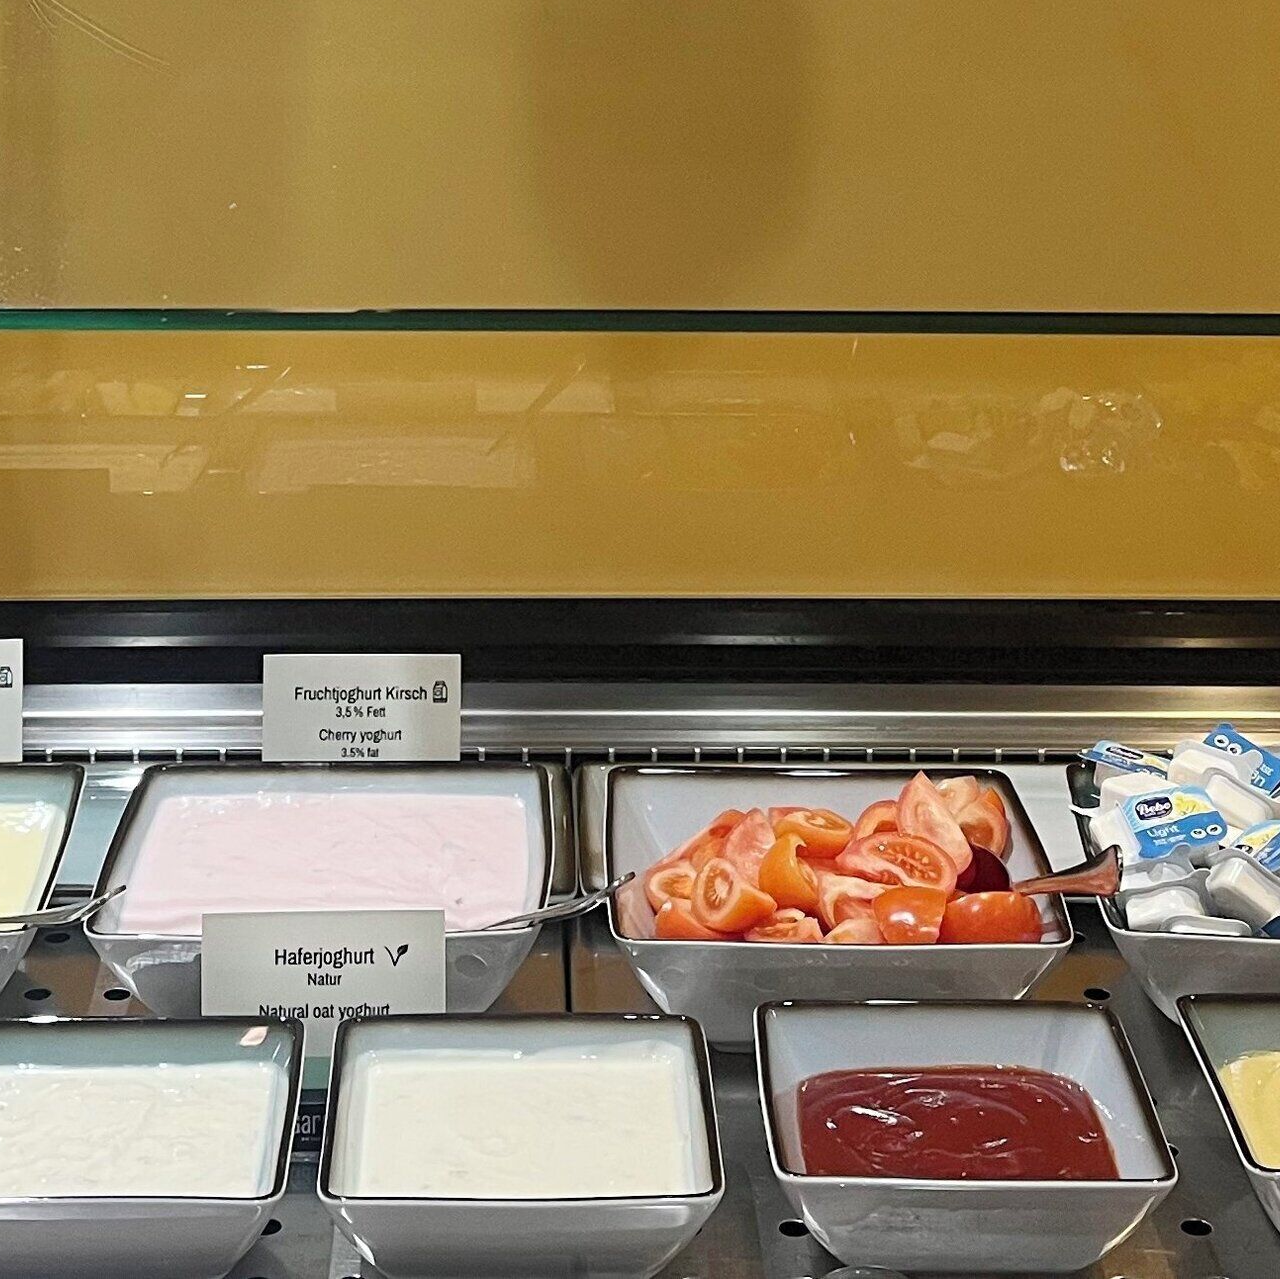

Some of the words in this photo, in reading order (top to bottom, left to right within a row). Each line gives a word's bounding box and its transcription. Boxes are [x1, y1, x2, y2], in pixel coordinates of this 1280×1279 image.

[294, 686, 381, 704] Fruchtjoghurt
[385, 686, 428, 701] Kirsch
[366, 706, 386, 718] Fett
[319, 728, 356, 743] Cherry
[360, 729, 402, 744] yoghurt
[341, 748, 365, 758] 3.5%
[367, 747, 379, 758] fat
[1146, 825, 1180, 840] Light
[274, 947, 376, 969] Haferjoghurt
[307, 972, 343, 987] Natur
[259, 1004, 309, 1018] Natural
[313, 1006, 334, 1018] oat
